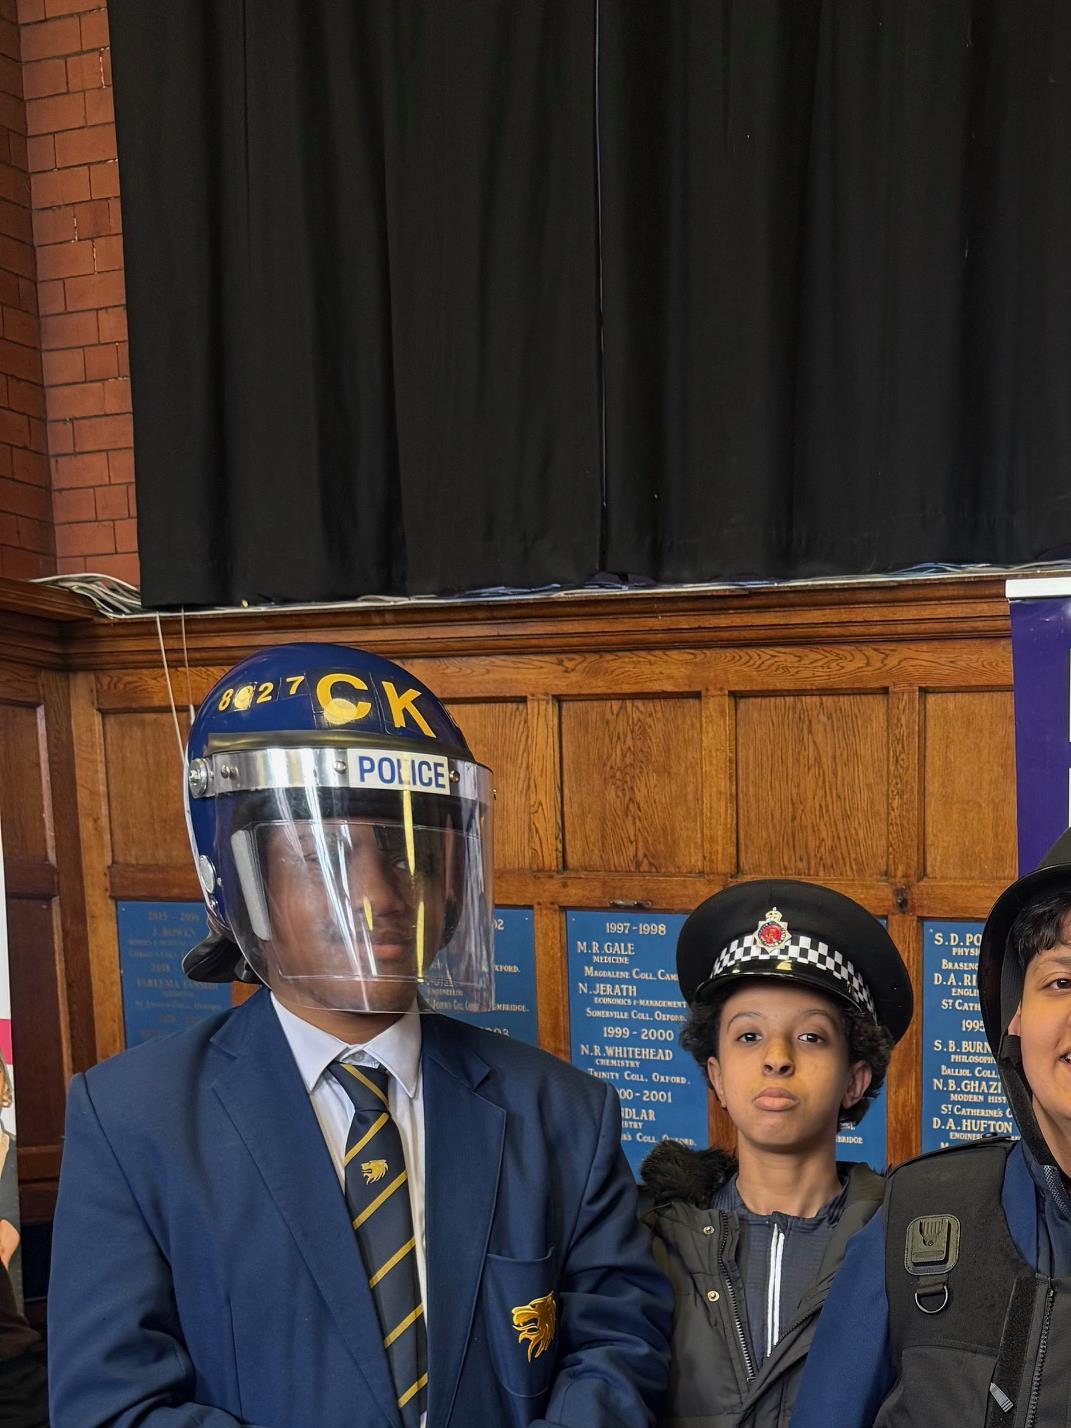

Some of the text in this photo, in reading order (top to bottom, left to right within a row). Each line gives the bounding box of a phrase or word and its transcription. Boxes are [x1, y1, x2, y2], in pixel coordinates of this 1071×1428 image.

[358, 755, 447, 789] POLICE
[592, 956, 630, 965] MEDICINE
[595, 1059, 641, 1068] CHEMISTRY
[950, 1094, 984, 1103] MODERN
[835, 1135, 863, 1144] BRIDGE
